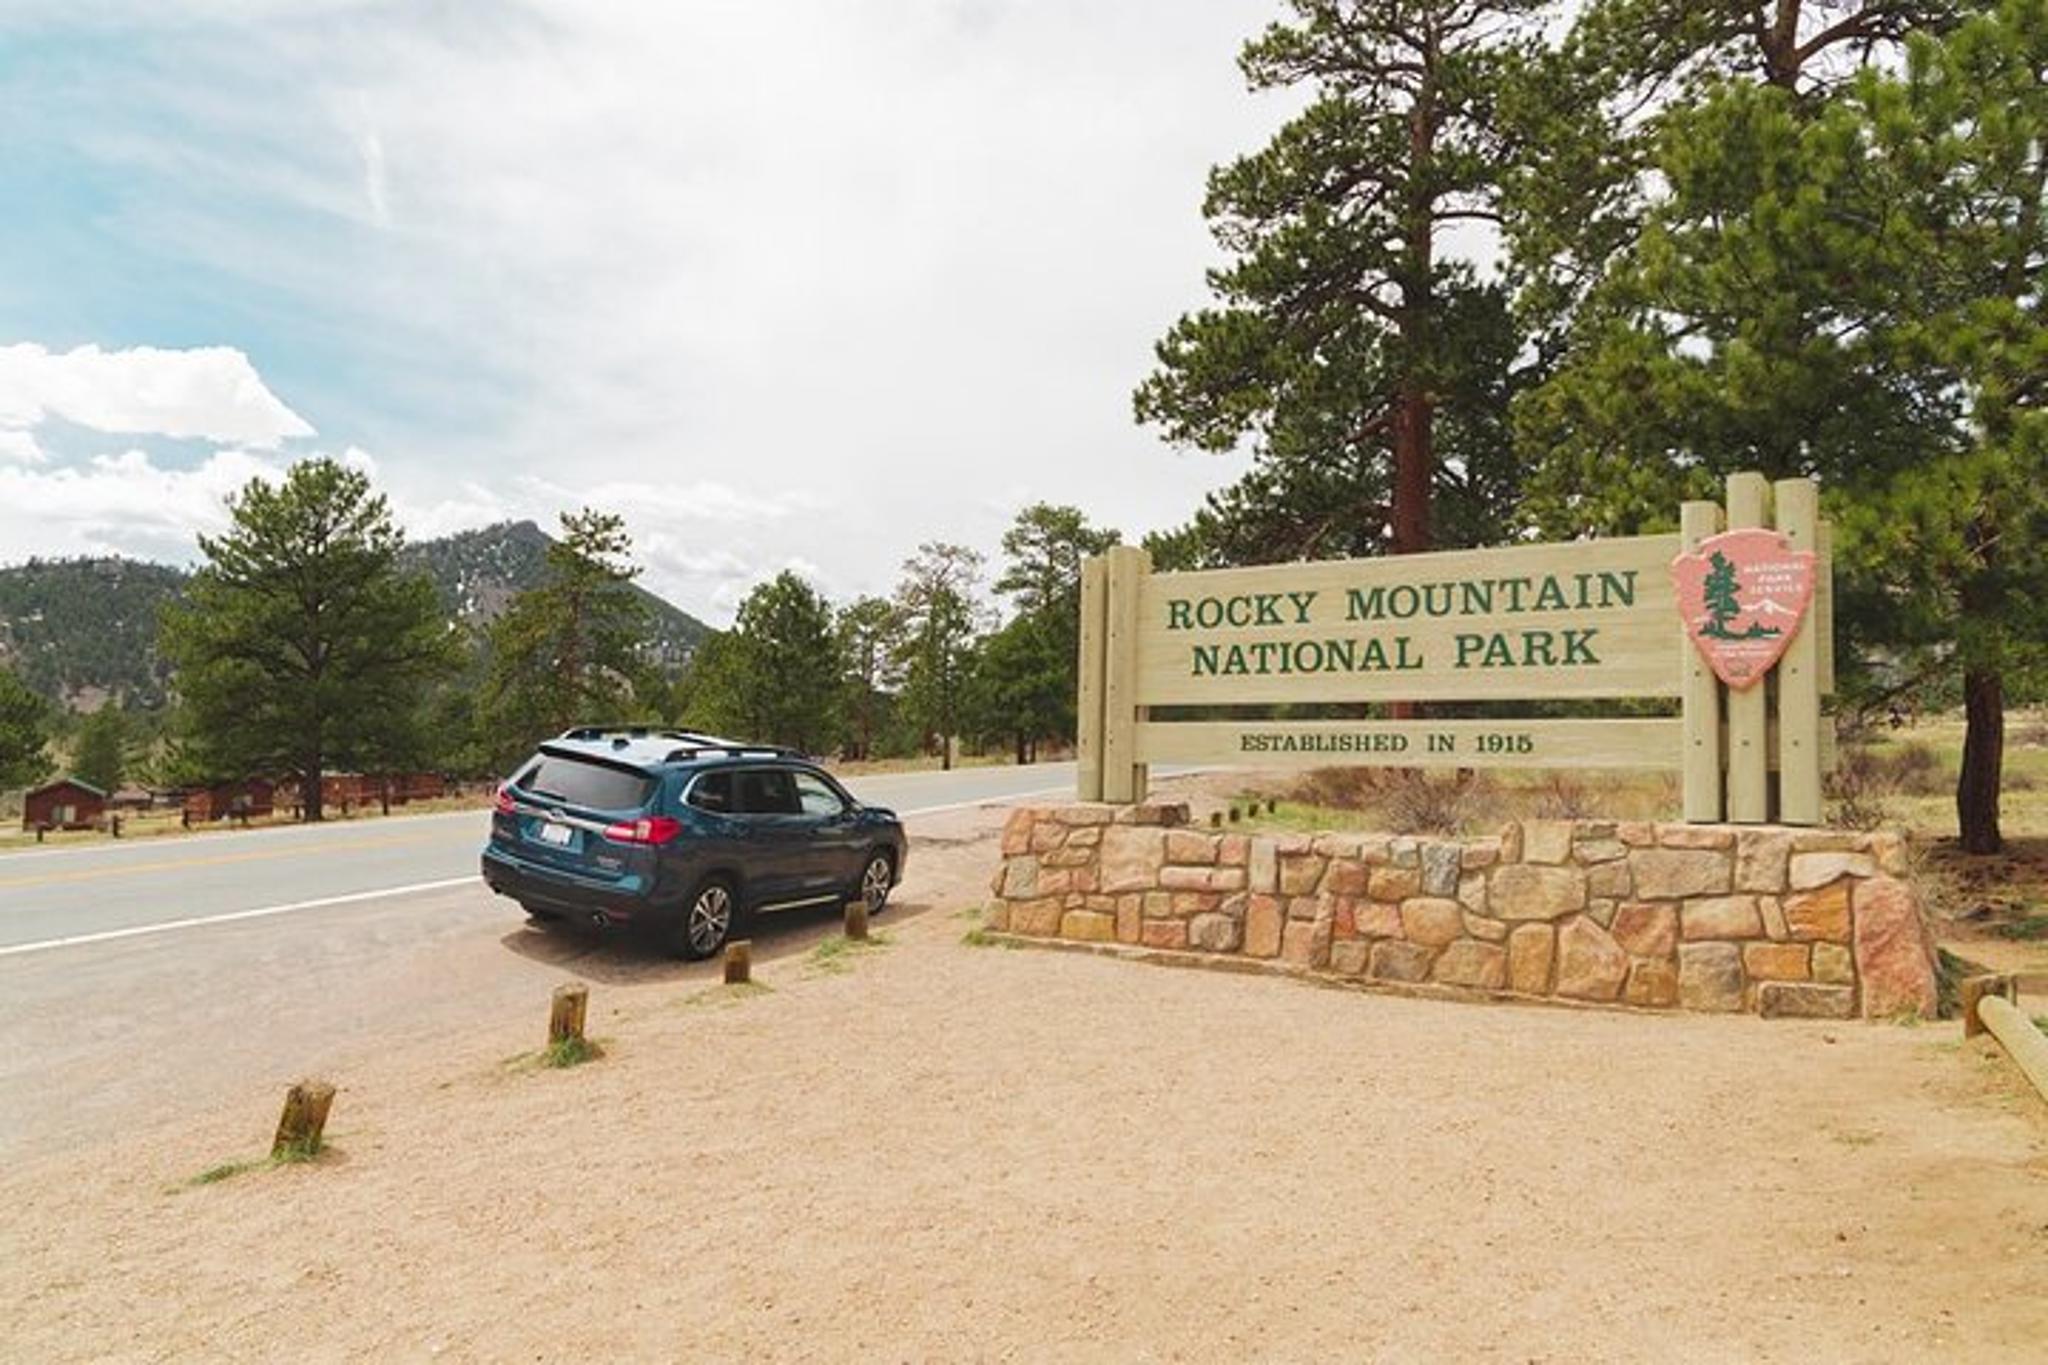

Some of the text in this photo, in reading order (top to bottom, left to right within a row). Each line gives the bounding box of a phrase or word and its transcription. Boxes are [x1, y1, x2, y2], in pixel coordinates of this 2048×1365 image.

[1167, 570, 1638, 630] ROCKY MOUNTAIN
[1192, 629, 1601, 676] NATIONAL PARK
[1240, 733, 1534, 754] ESTABLISHED IN 1915
